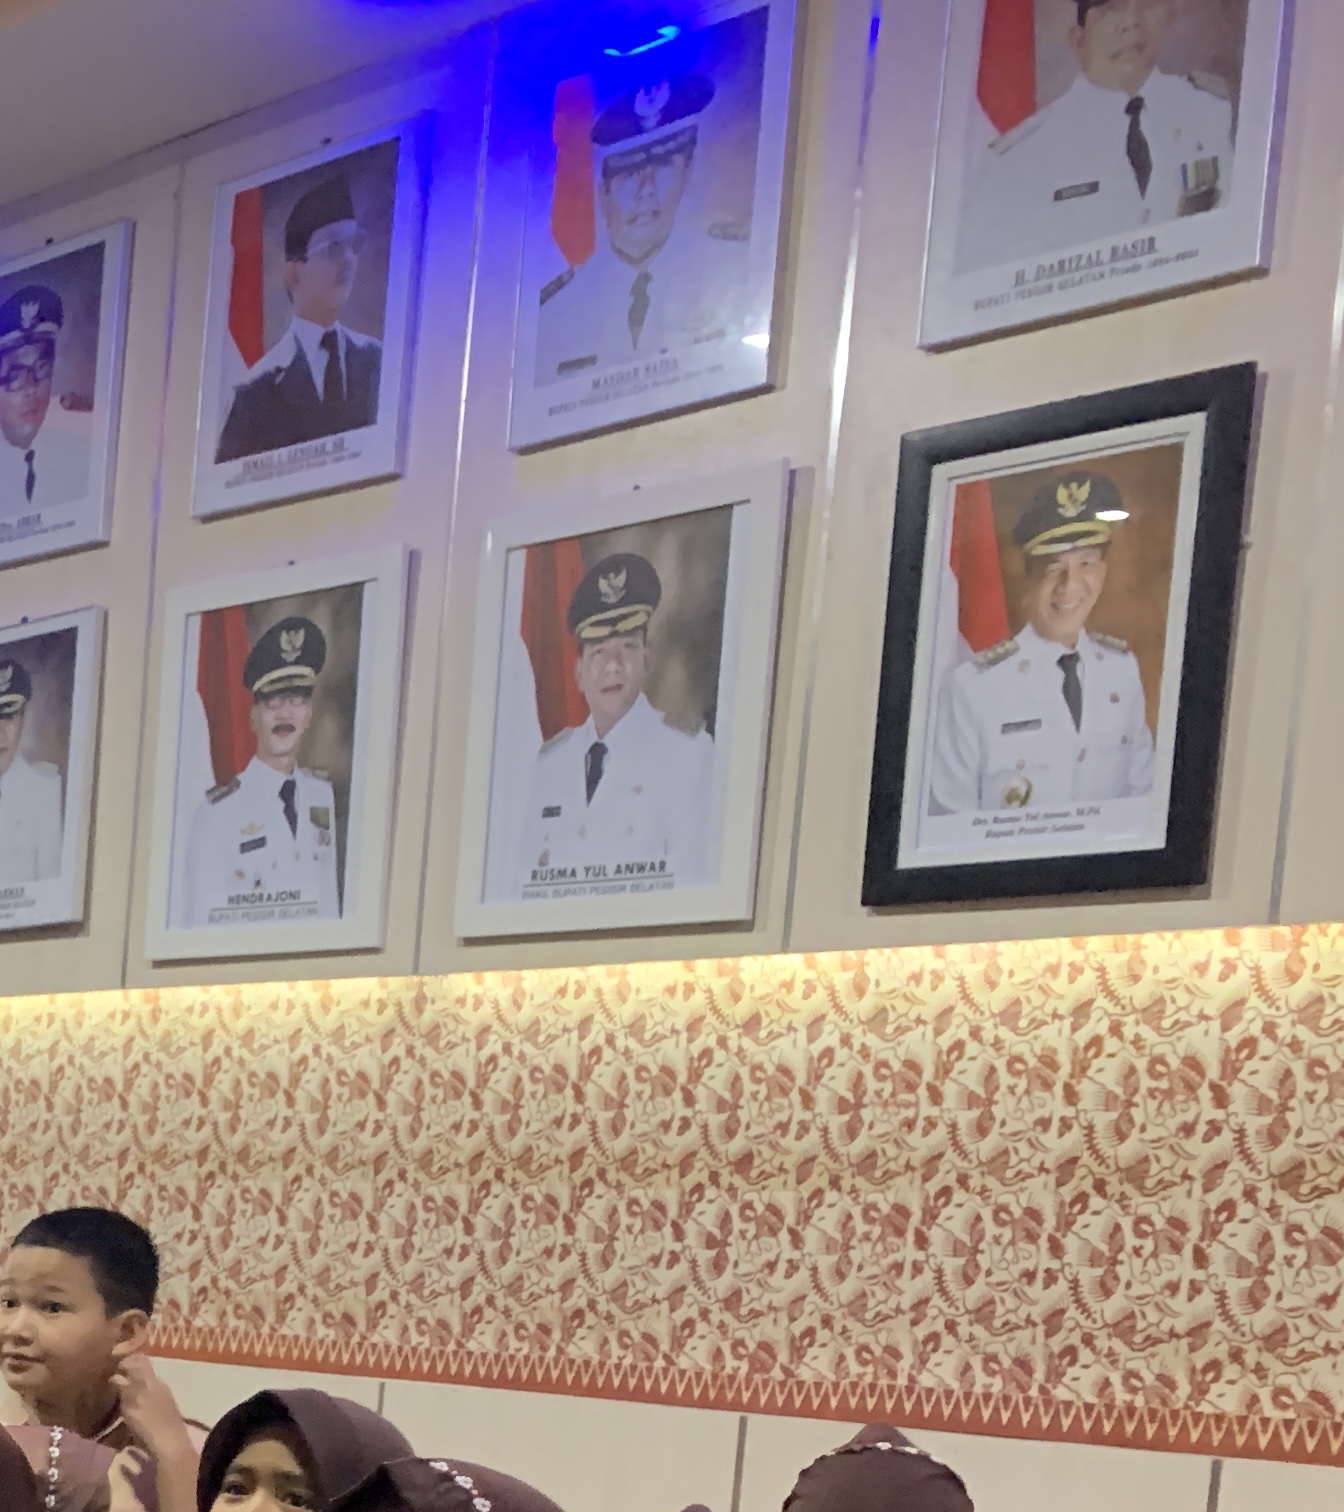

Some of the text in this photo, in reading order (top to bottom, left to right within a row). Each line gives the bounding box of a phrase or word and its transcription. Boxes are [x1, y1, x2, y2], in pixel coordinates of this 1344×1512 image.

[1034, 250, 1103, 282] DARIZAL
[1110, 236, 1157, 263] BASIR
[530, 860, 667, 883] RUSMA YUL ANWAR
[227, 889, 301, 906] HENDRAJONI
